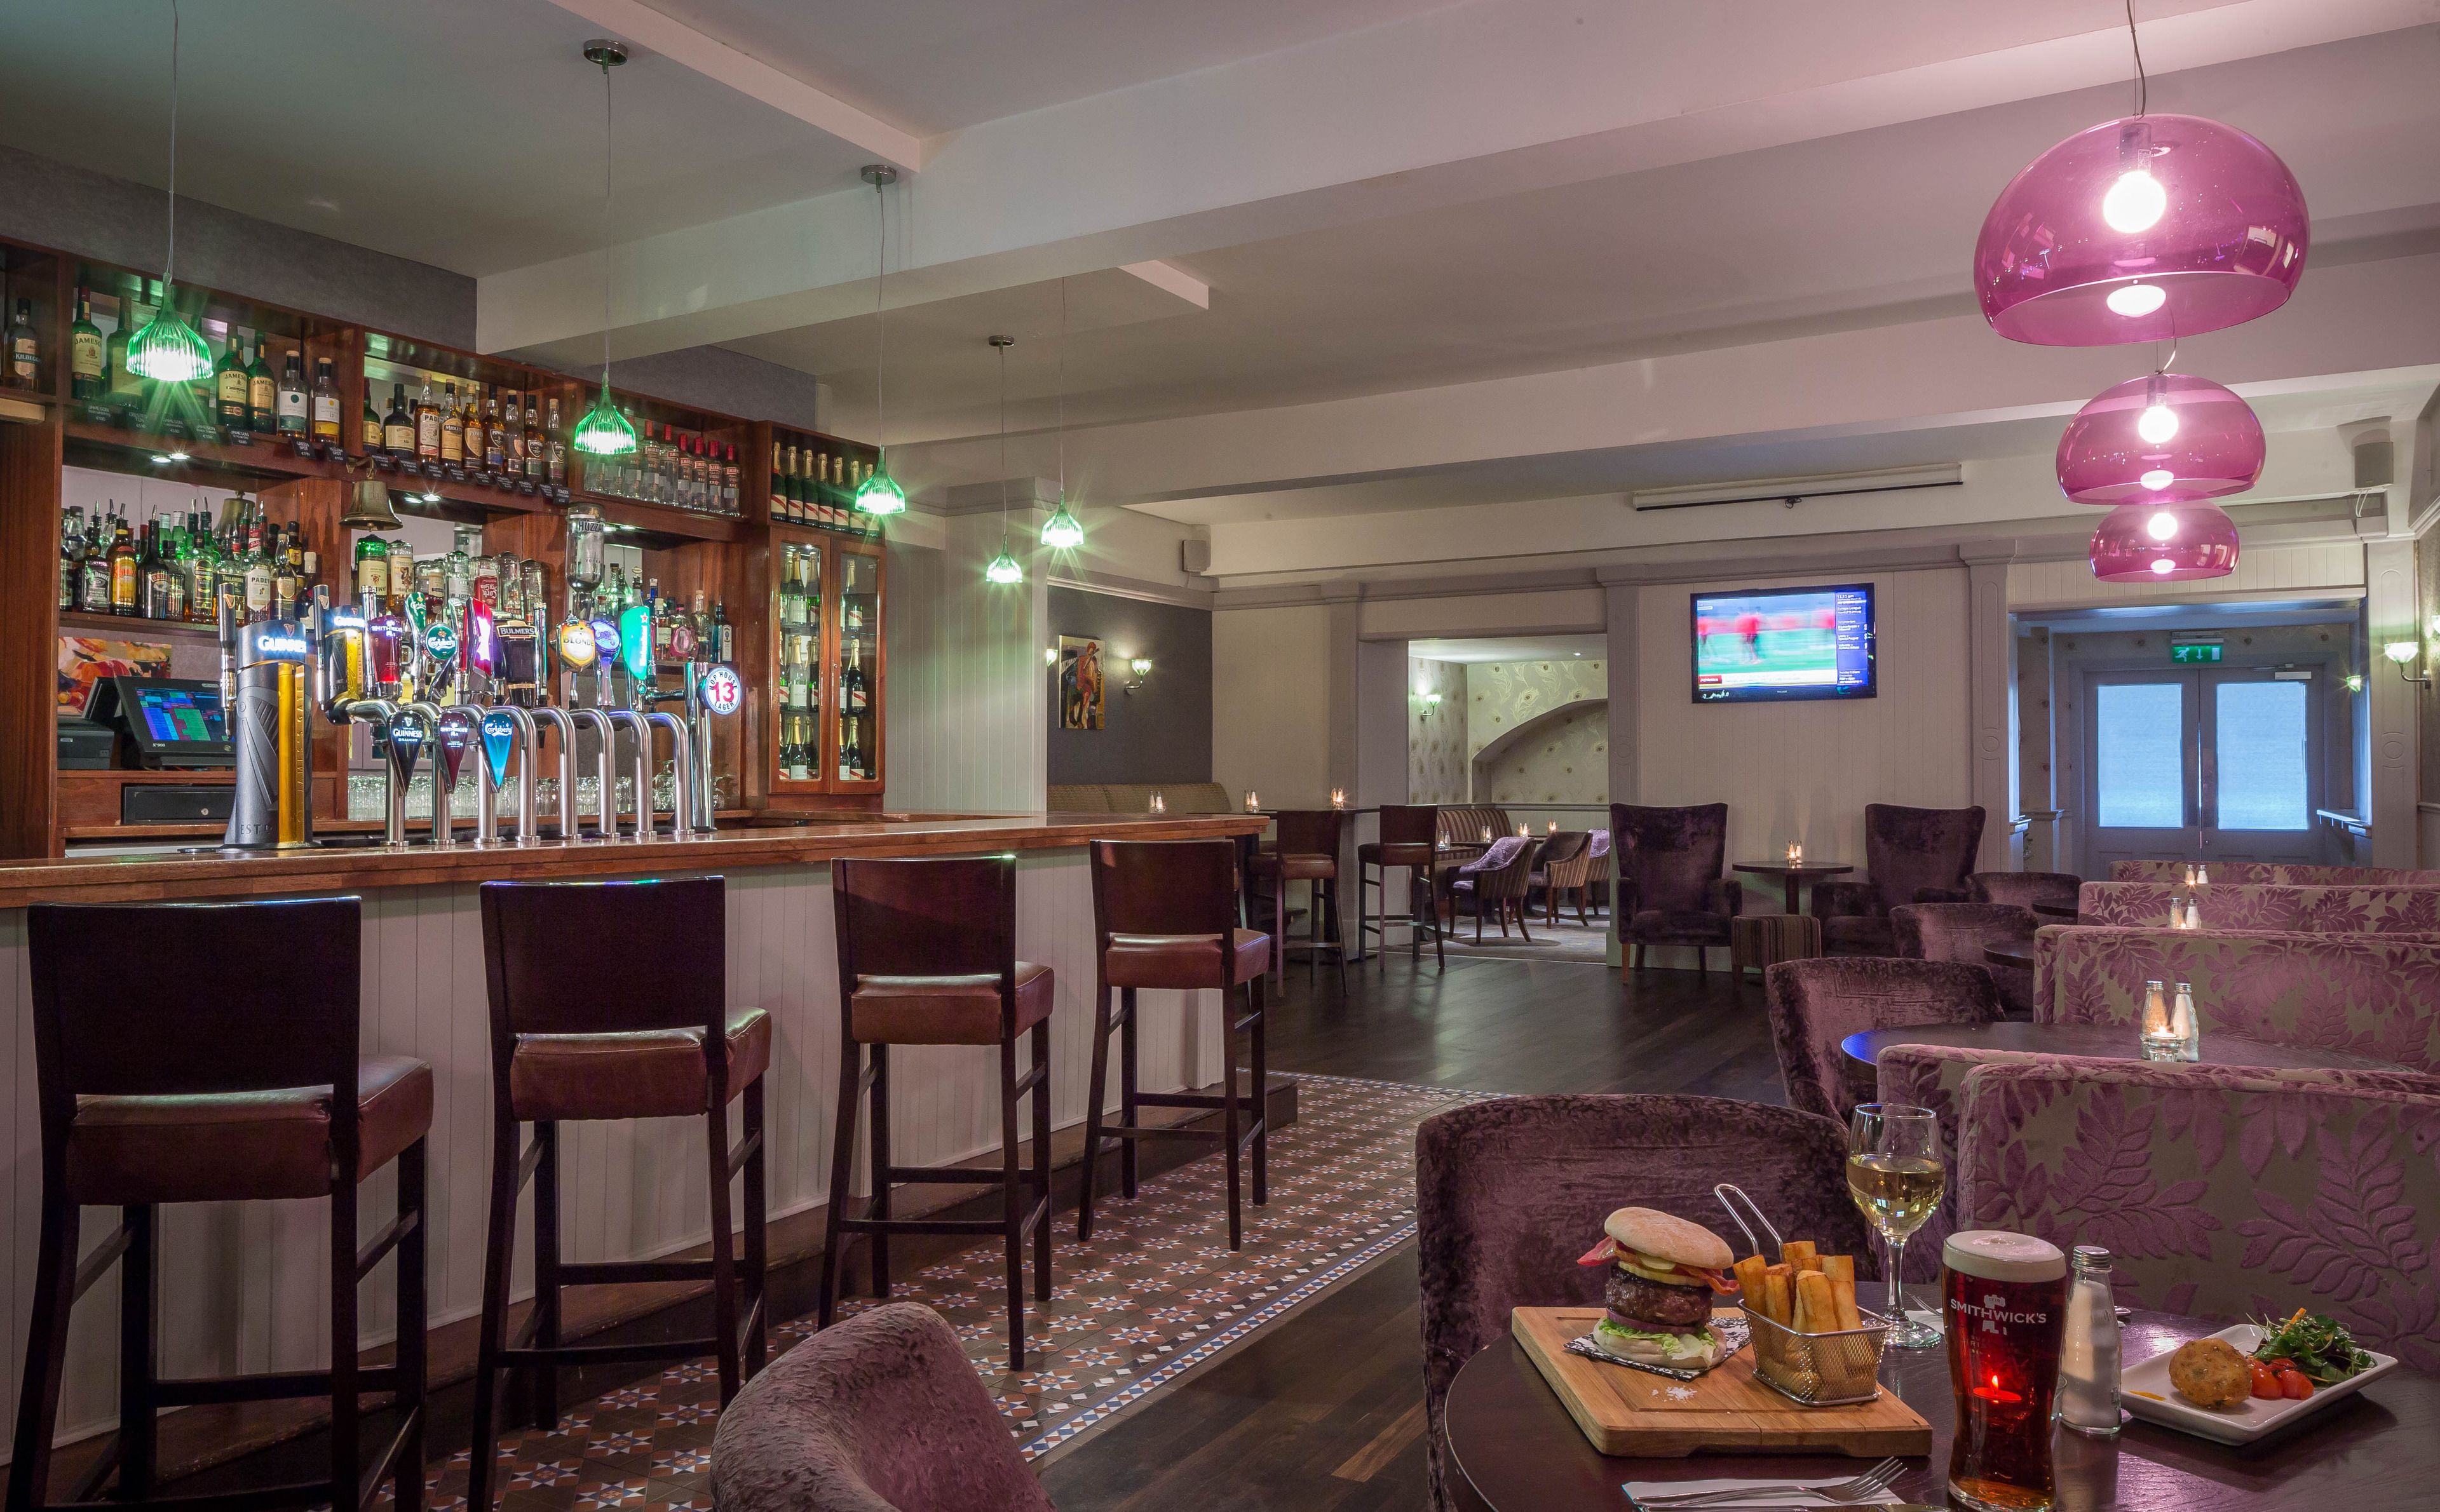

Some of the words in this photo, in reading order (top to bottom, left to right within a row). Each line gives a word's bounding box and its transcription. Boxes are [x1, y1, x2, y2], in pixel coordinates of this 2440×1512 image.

[563, 635, 595, 647] BLONDE
[719, 672, 738, 691] HOUSE
[713, 682, 735, 702] 13
[714, 701, 734, 710] LAGER
[393, 727, 423, 738] GUINNESS
[485, 722, 512, 738] Carlsberg
[1950, 1298, 2047, 1324] SMITHWICK'S
